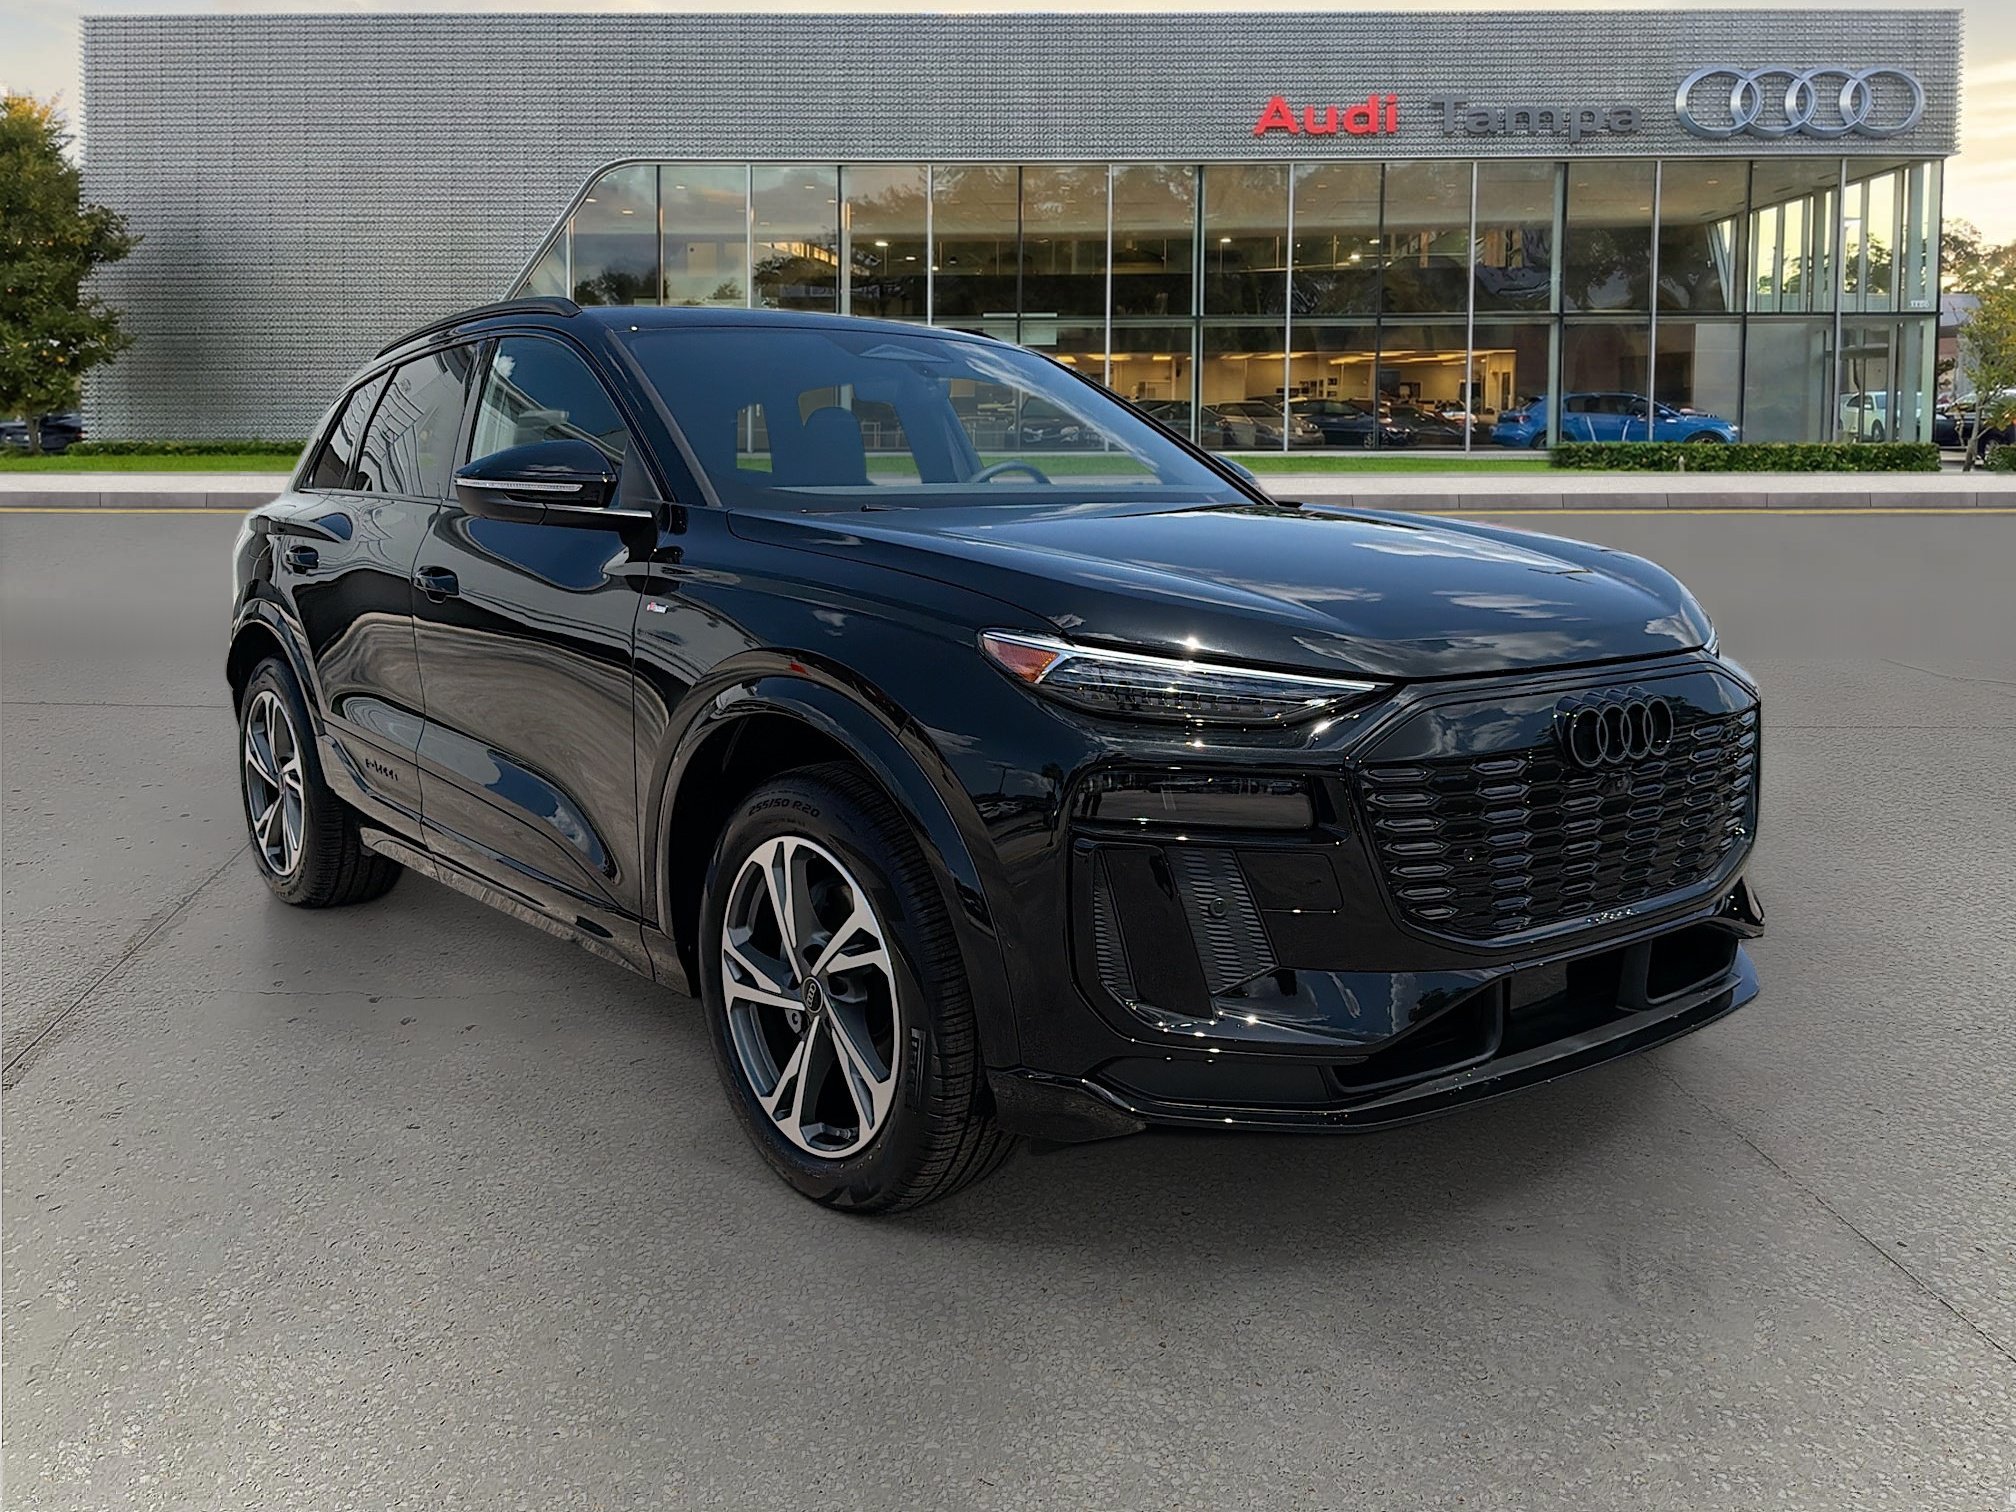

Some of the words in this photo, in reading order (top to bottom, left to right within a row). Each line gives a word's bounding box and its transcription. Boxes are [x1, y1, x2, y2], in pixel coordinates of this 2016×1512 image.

[1253, 94, 1397, 134] Audi
[1431, 95, 1642, 143] Tampa
[748, 798, 790, 816] 255/50
[792, 800, 820, 818] R20
